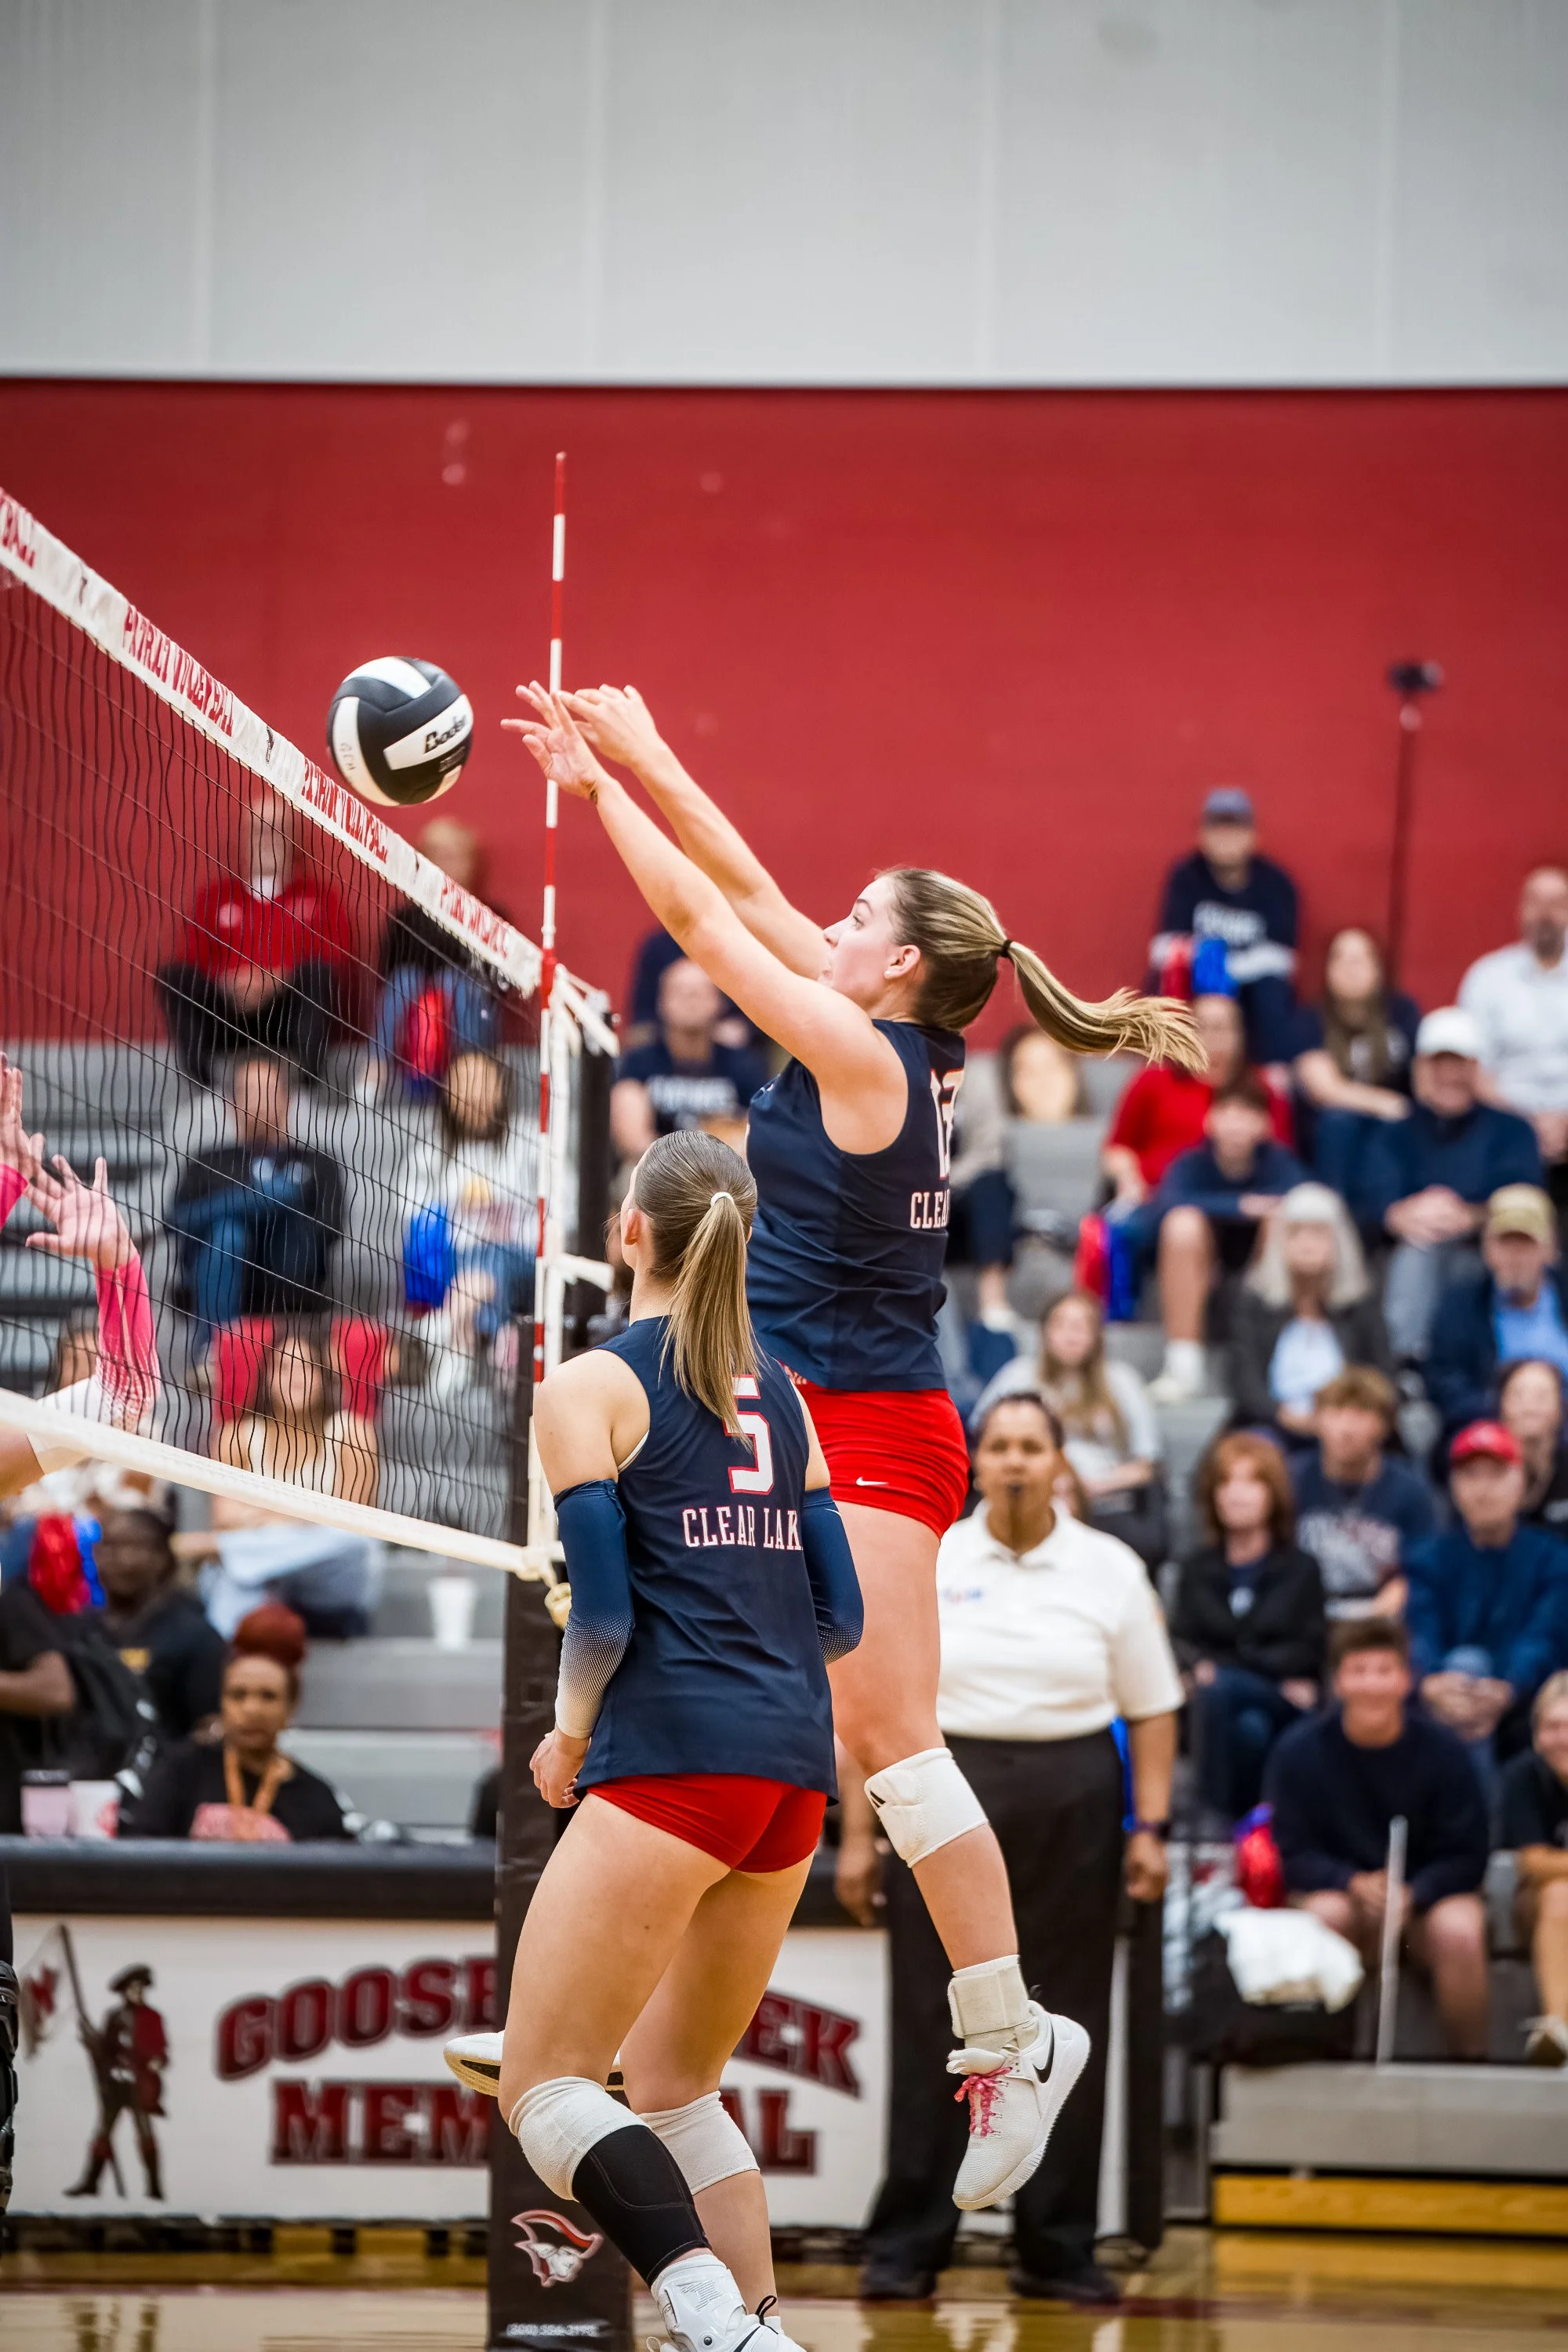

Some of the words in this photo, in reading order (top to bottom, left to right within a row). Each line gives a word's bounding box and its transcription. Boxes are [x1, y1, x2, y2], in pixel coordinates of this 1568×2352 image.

[909, 1189, 950, 1229] CLEA
[723, 1374, 775, 1495] 5
[682, 1504, 756, 1548] CLEAR
[764, 1507, 803, 1551] LAK
